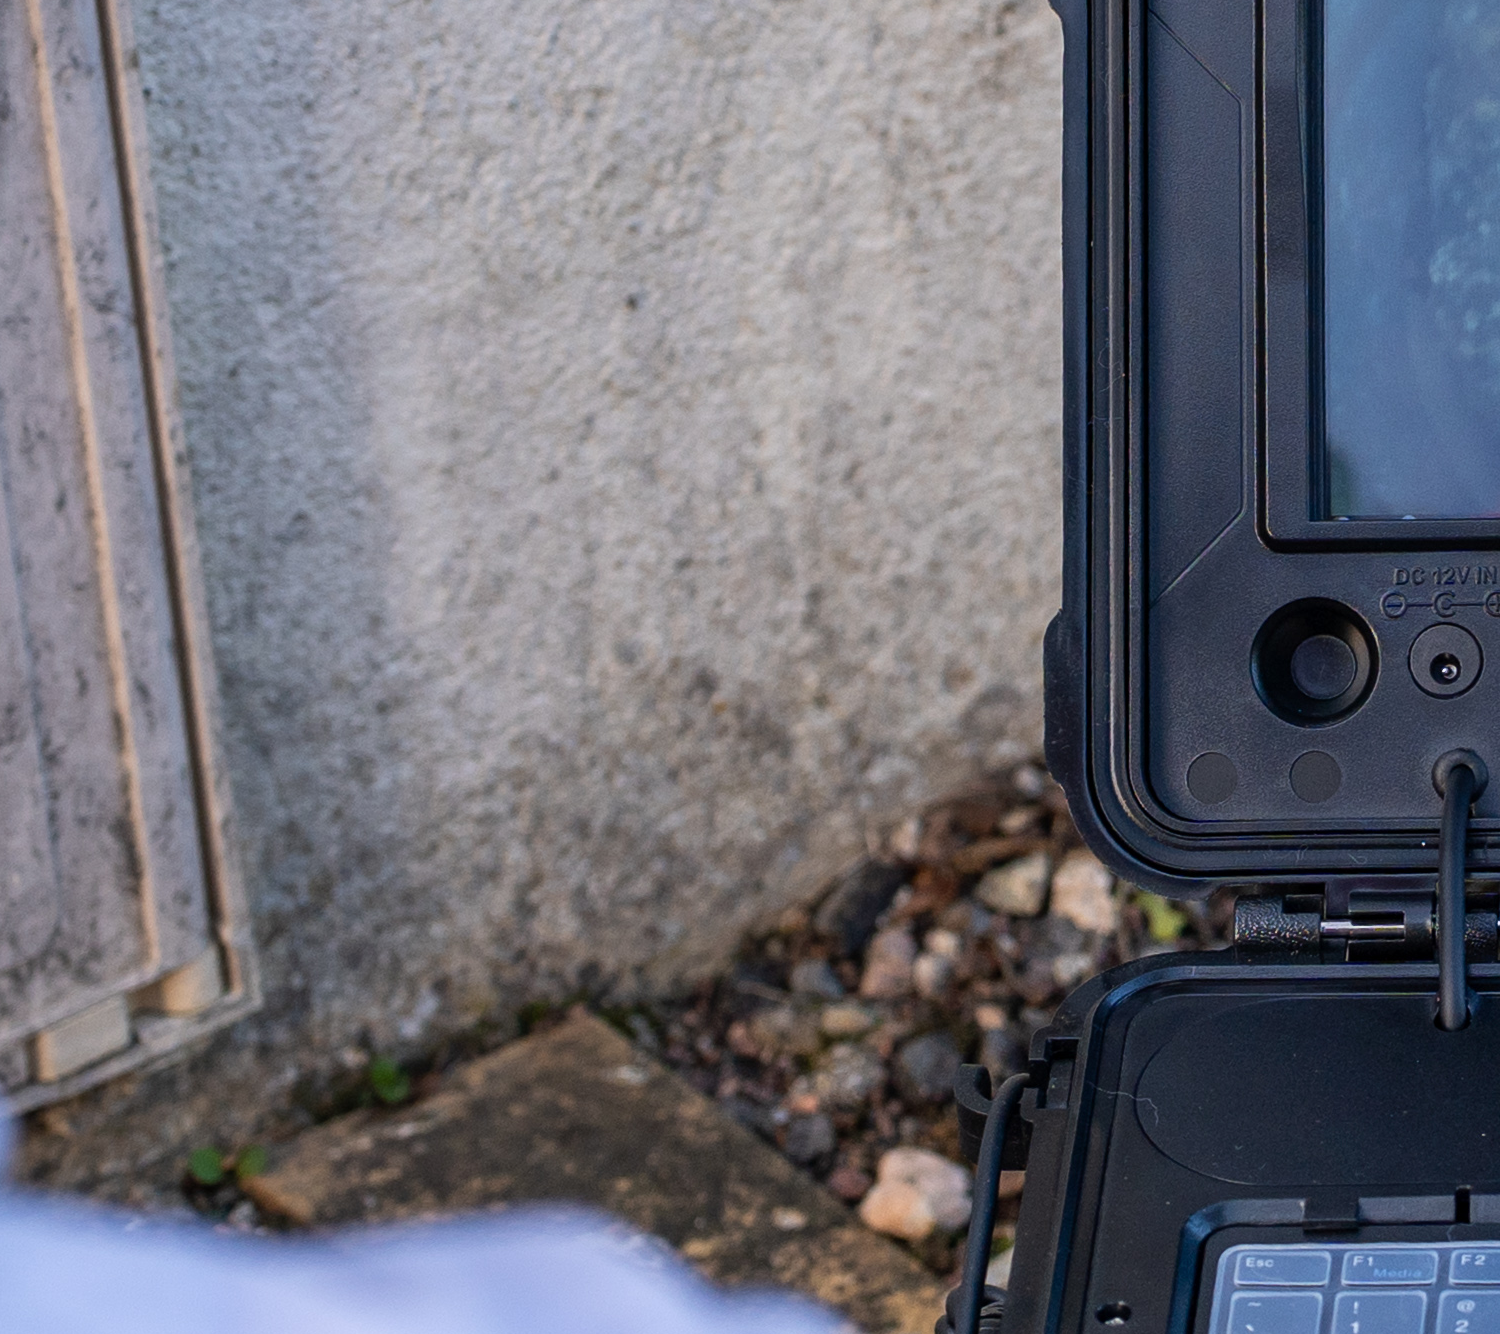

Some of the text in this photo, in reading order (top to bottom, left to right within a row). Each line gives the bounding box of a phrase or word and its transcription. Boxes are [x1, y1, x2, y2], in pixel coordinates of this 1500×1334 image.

[1393, 566, 1498, 585] DC 12V IN
[1246, 1257, 1273, 1267] Esc
[1353, 1256, 1373, 1266] F1
[1461, 1254, 1485, 1265] F2
[1457, 1300, 1475, 1313] @
[1351, 1322, 1359, 1334] 1
[1455, 1320, 1469, 1333] 2
